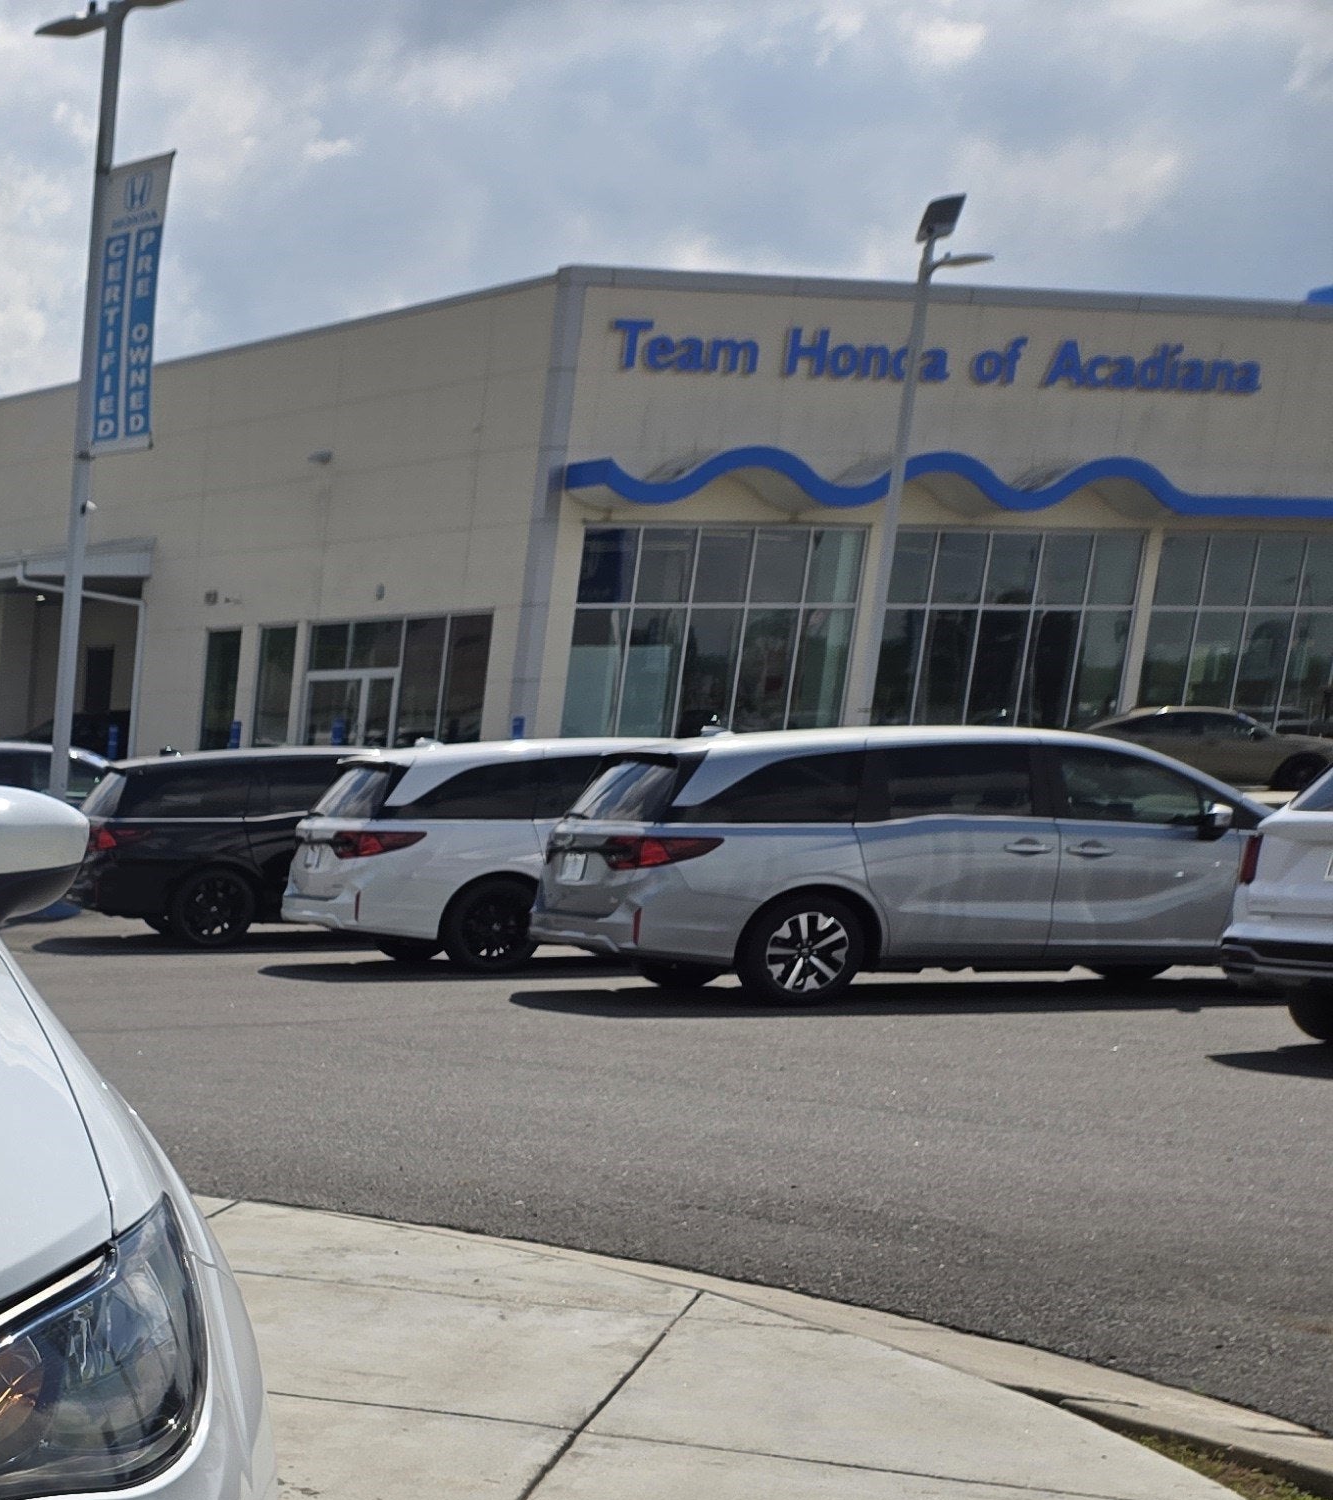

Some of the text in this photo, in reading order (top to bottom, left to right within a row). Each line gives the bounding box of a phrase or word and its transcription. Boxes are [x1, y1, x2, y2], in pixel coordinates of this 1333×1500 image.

[96, 237, 127, 438] CERTIFIED
[129, 230, 156, 433] PRE OWNED
[612, 317, 760, 376] Team
[971, 335, 1029, 386] of
[1041, 338, 1262, 394] Acadiana
